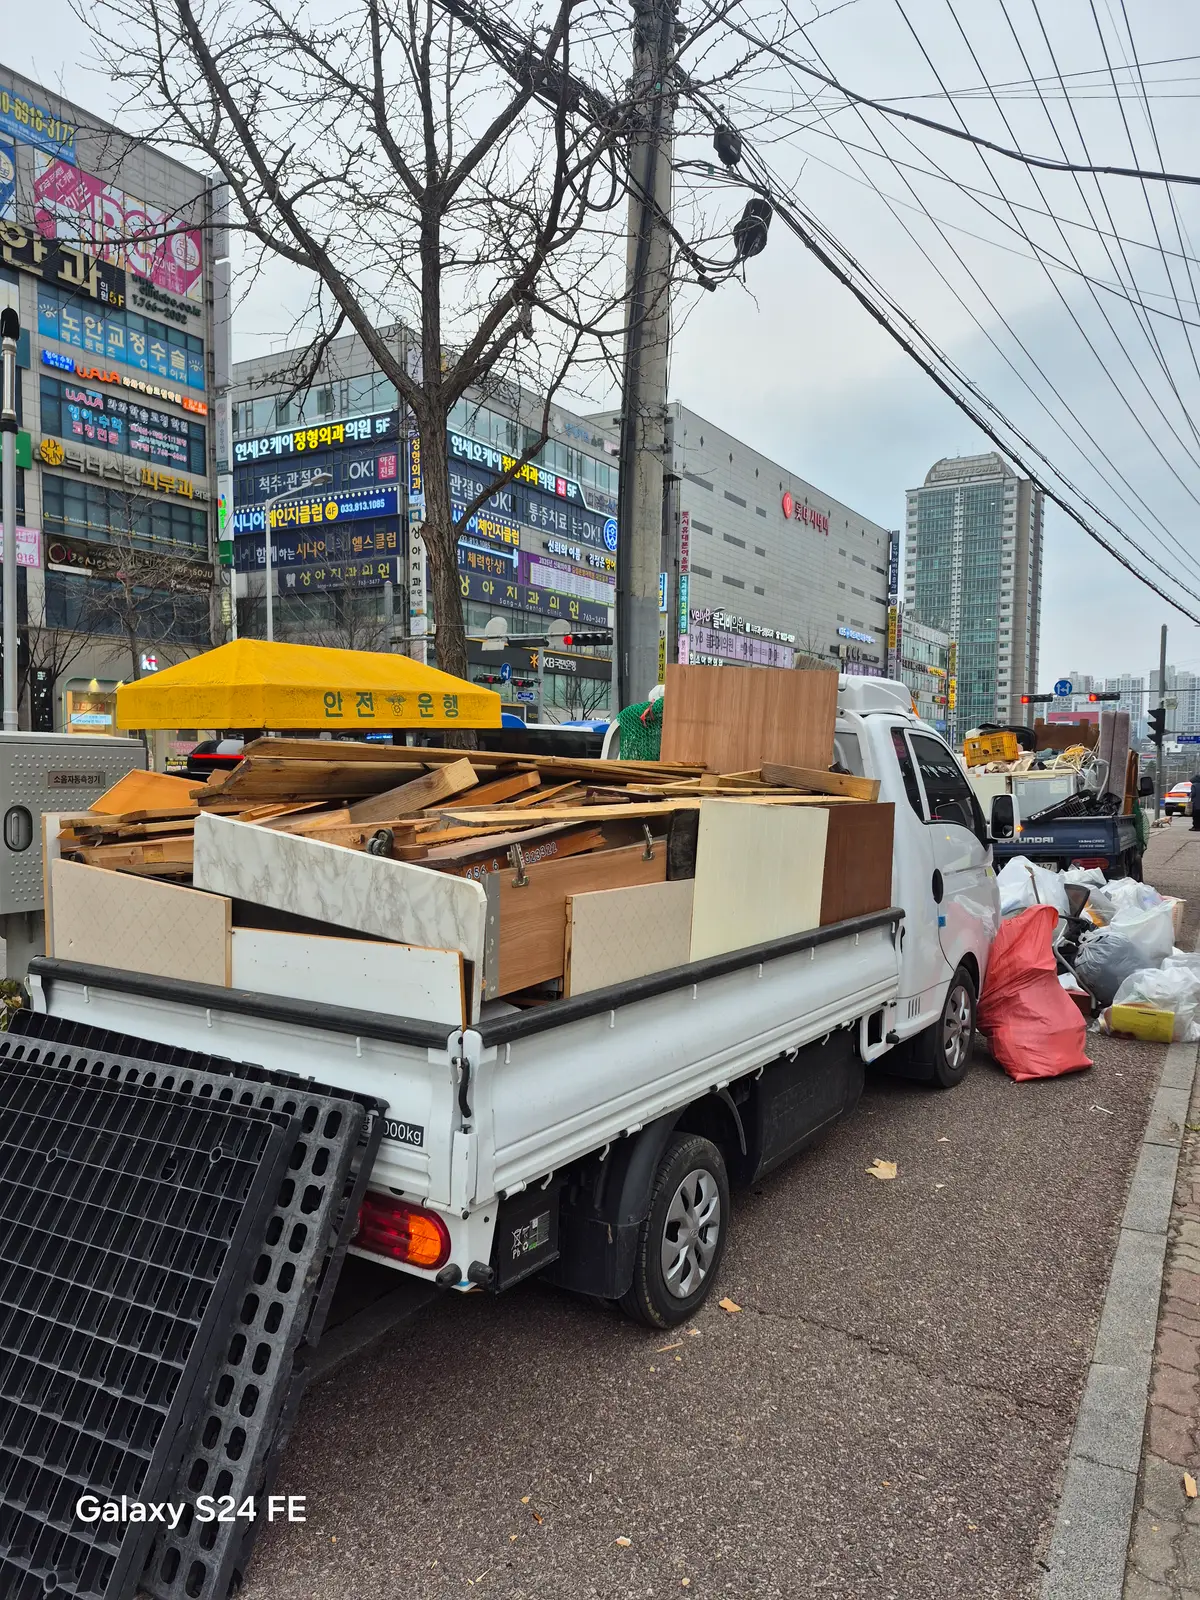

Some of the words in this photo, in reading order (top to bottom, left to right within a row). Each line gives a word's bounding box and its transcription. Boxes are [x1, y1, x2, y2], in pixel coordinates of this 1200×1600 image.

[62, 307, 186, 371] 노안교정수술
[235, 418, 372, 461] 연세오케이정형외과의원
[375, 417, 391, 433] 5F
[349, 460, 374, 481] OK!
[340, 498, 385, 514] 033.813.1085
[278, 548, 295, 561] 하는
[352, 531, 397, 553] 헬스클럽
[547, 539, 568, 557] 신뢰의
[568, 547, 583, 561] 이름
[192, 568, 213, 579] SOJU
[299, 562, 390, 586] 상아치과의원
[467, 551, 506, 575] 체력향상!
[582, 612, 607, 625] 763-3477
[142, 654, 159, 671] kt
[543, 656, 577, 672] KB국민은행
[323, 691, 375, 718] 안전
[417, 692, 459, 718] 운행
